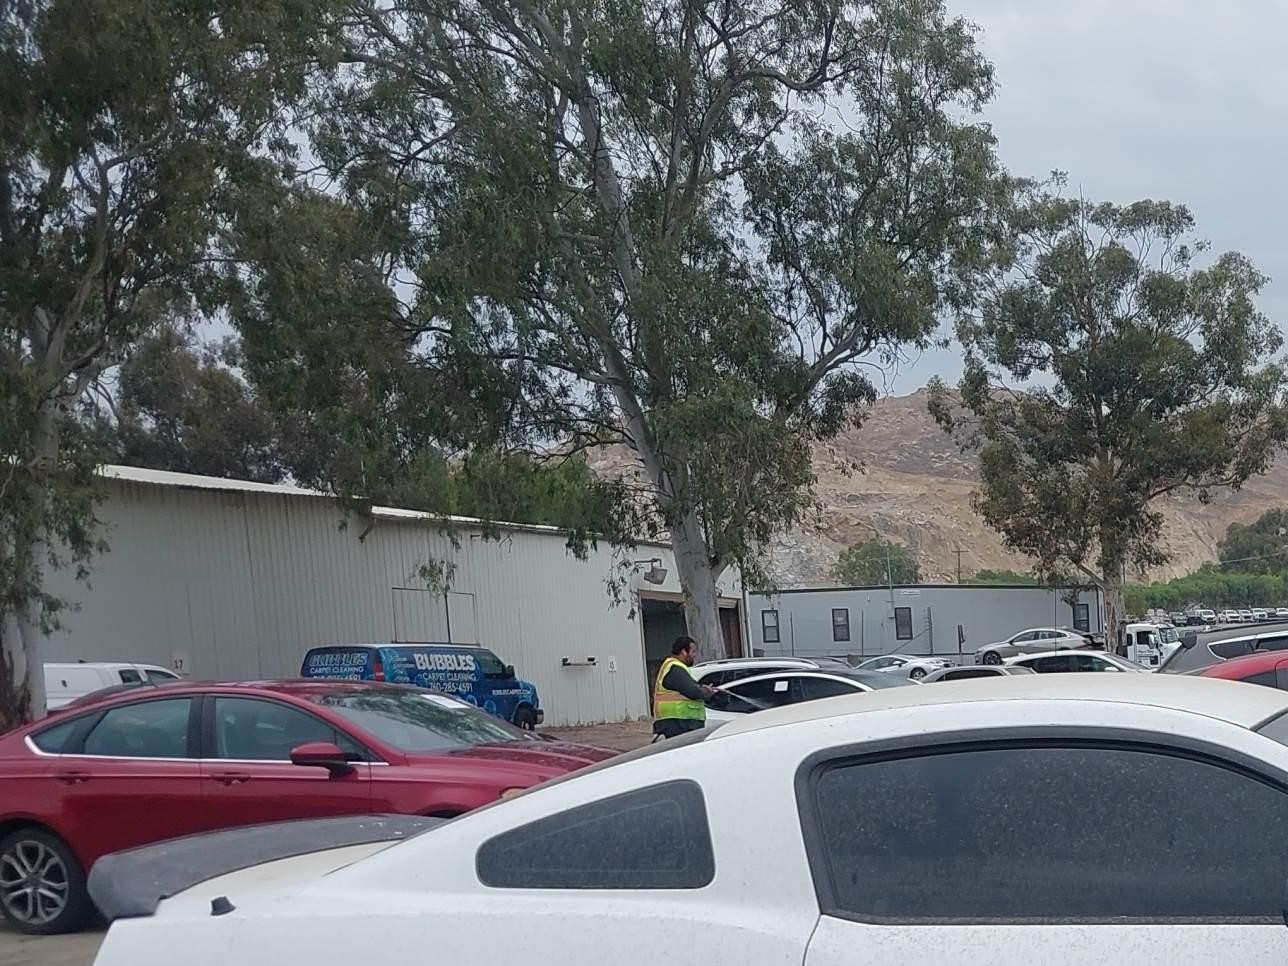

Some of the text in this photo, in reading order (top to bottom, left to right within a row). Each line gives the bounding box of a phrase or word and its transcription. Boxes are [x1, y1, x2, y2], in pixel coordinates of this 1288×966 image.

[309, 653, 368, 666] BUBBLES
[414, 653, 476, 671] BUBBLES
[332, 666, 364, 674] CLEANING
[423, 672, 476, 682] CARPET CLEANING
